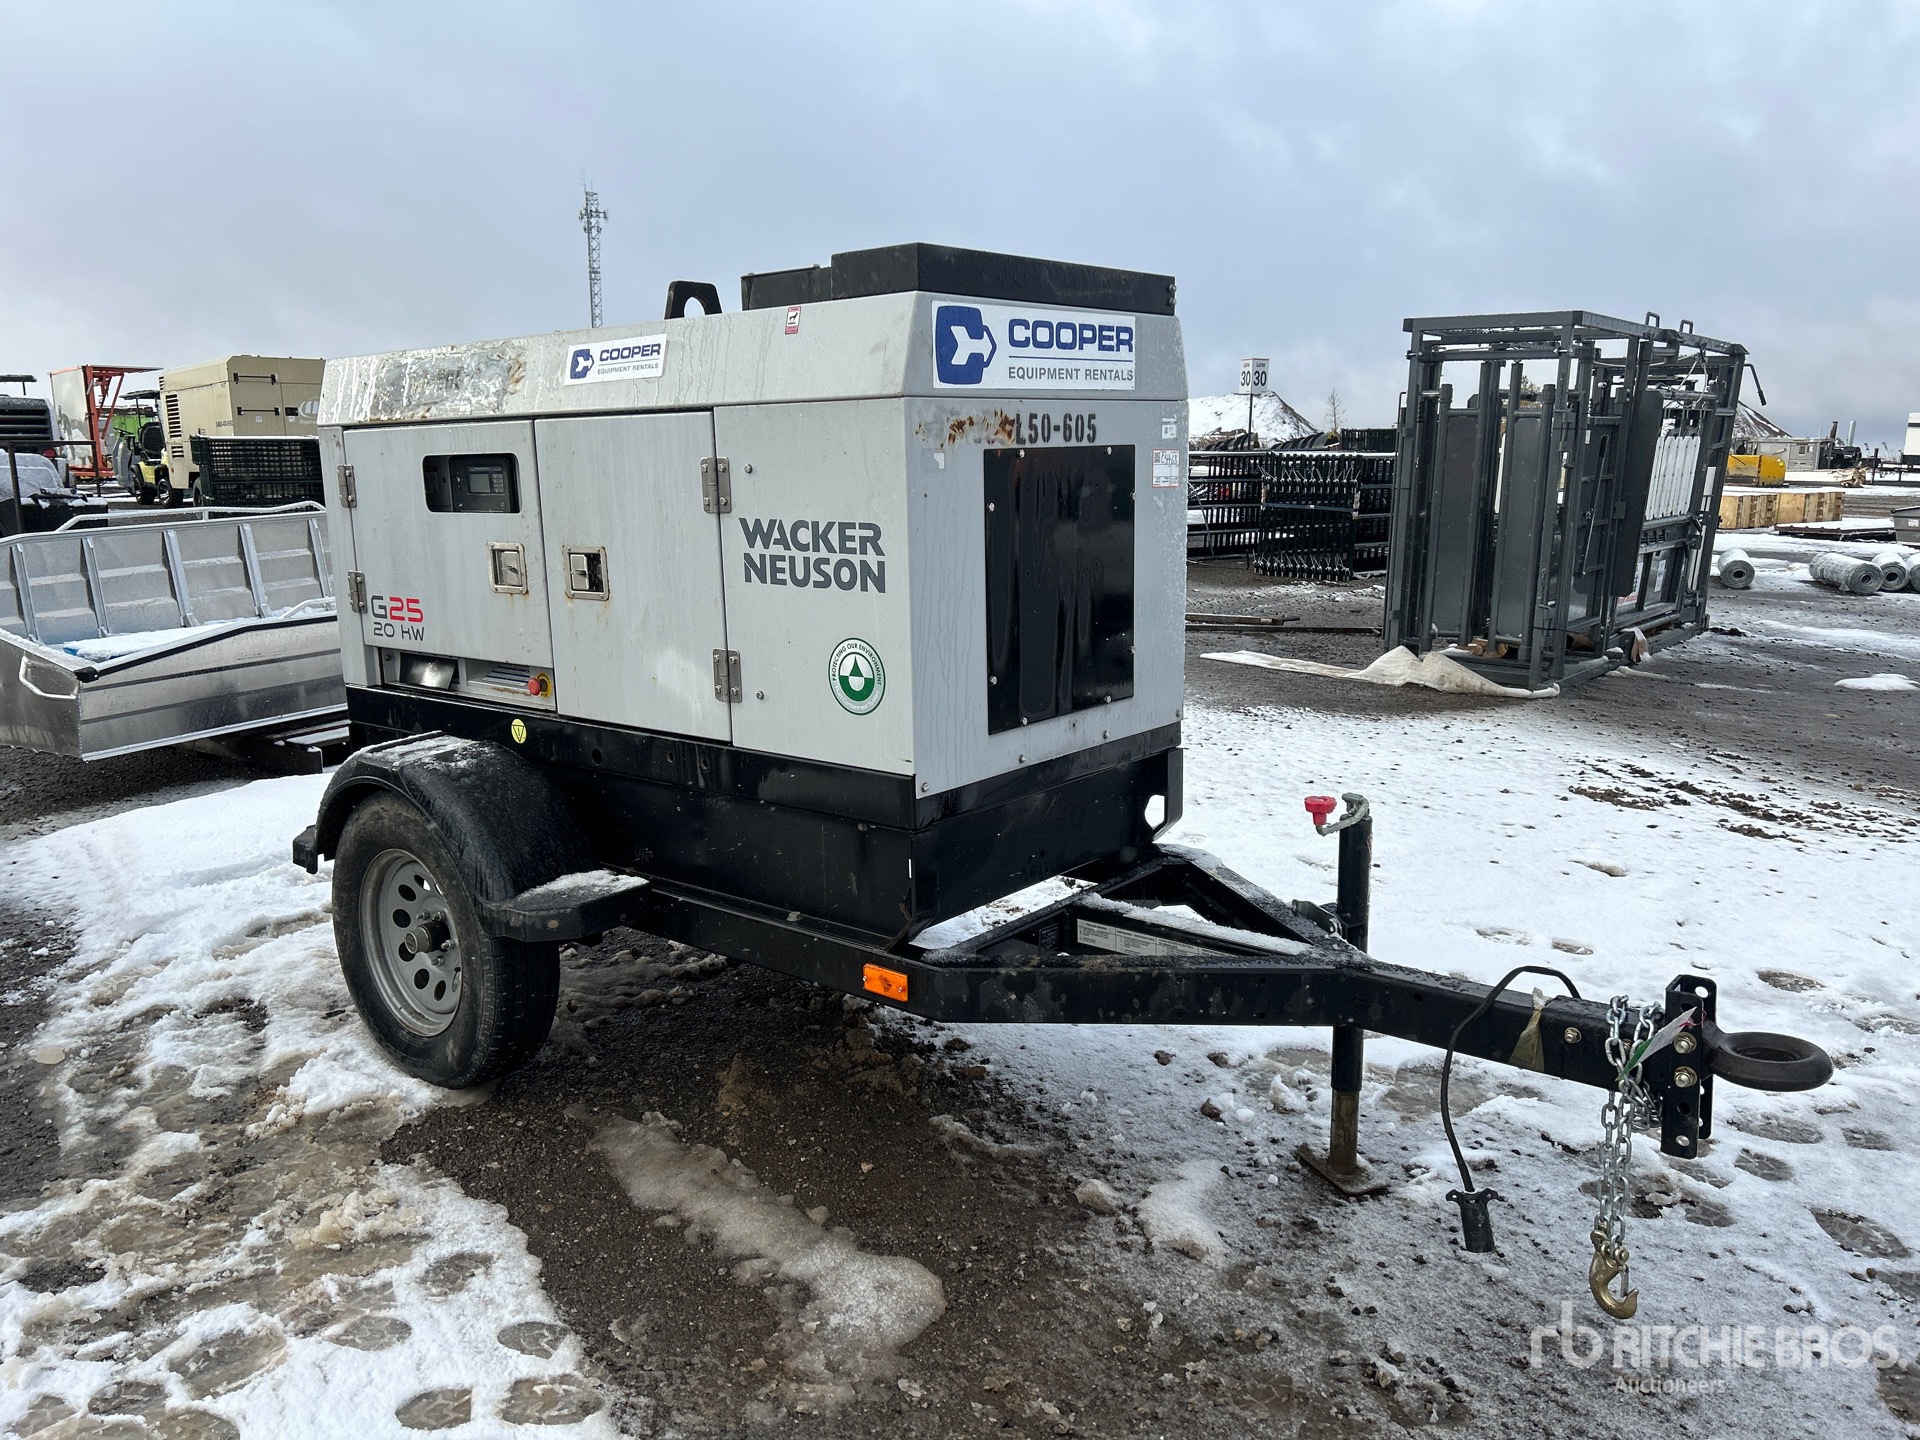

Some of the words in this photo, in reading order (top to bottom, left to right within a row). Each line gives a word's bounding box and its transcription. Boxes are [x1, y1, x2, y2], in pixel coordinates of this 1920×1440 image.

[1008, 318, 1134, 353] COOPER
[599, 343, 662, 362] COOPER
[597, 366, 631, 375] EQUIPMENT
[632, 362, 659, 371] RENTALS
[1008, 366, 1081, 381] EQUIPMENT
[1084, 368, 1134, 381] RENTALS
[1240, 370, 1251, 387] 30
[1253, 370, 1267, 387] 30
[738, 517, 886, 557] WACKER
[743, 552, 887, 594] NEUSON
[370, 594, 424, 623] G25
[373, 621, 395, 638] 20
[831, 645, 847, 681] PROTECTING
[846, 642, 858, 650] OUR
[858, 643, 882, 686] ENVIRONMENT
